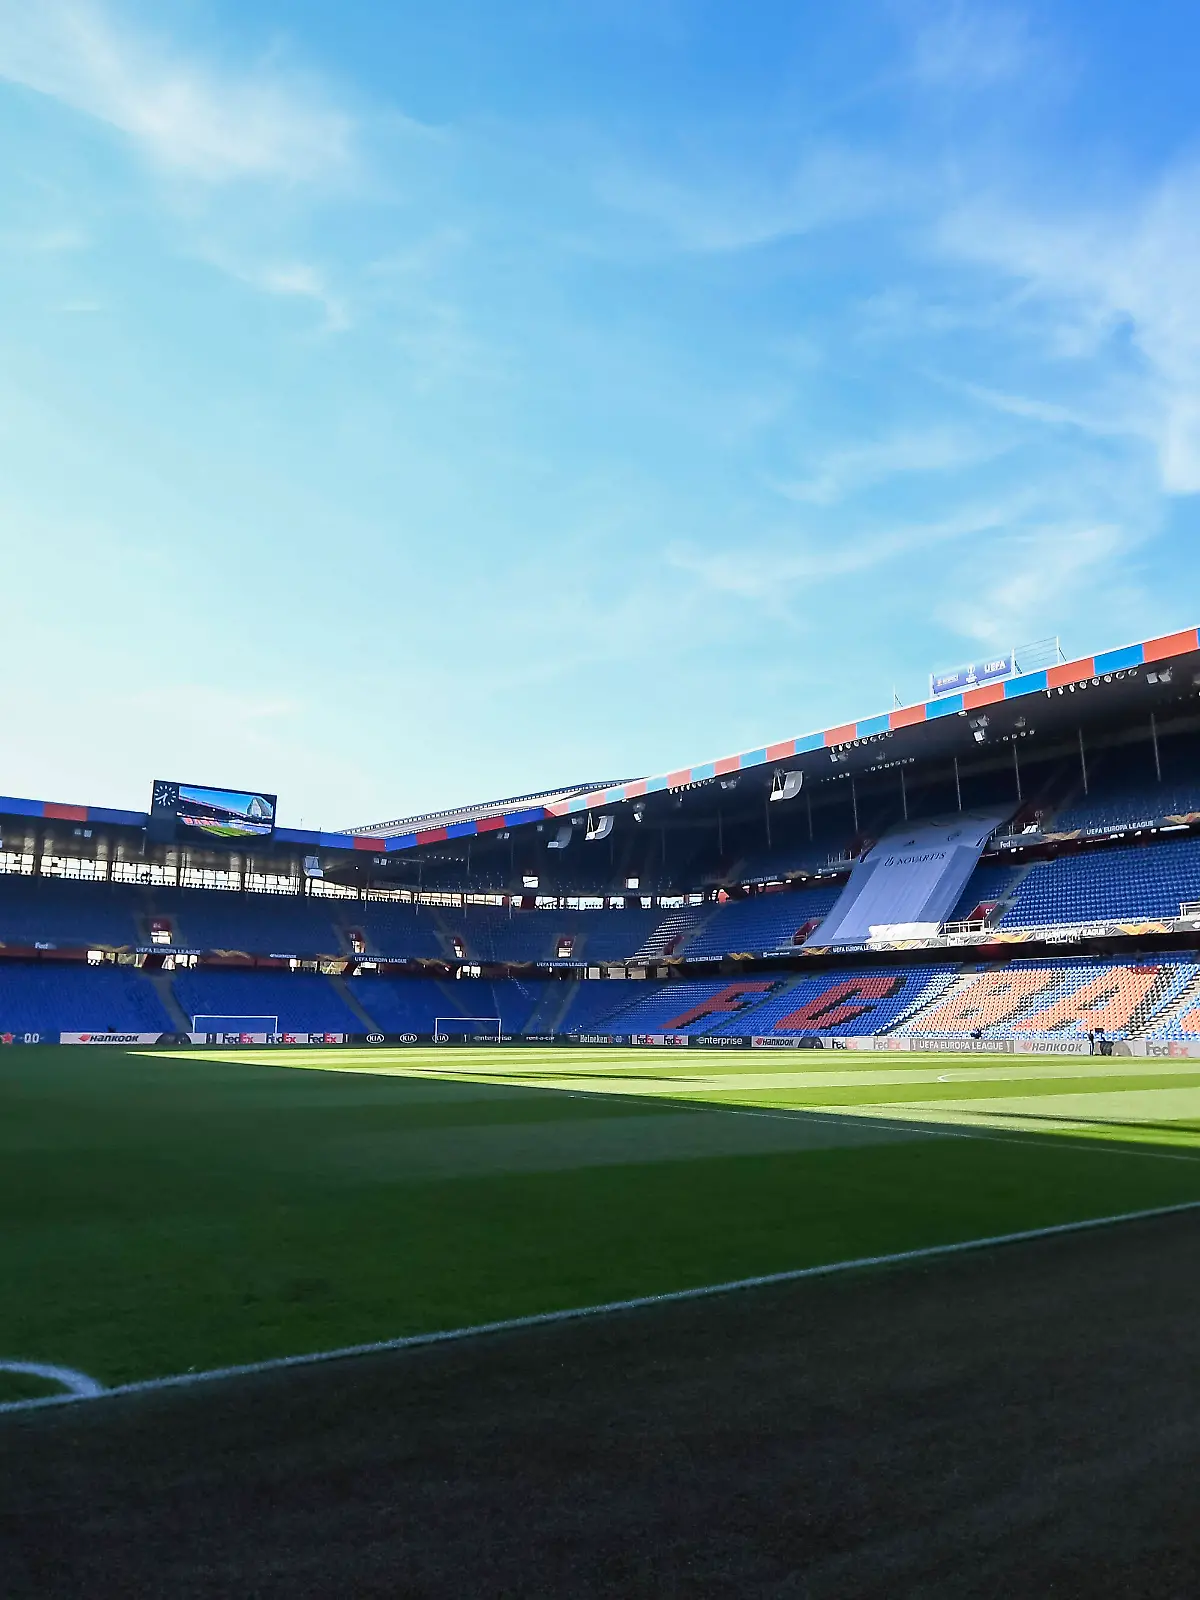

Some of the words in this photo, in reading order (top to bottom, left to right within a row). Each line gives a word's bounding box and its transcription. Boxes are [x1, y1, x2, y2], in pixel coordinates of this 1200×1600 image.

[984, 660, 1005, 674] UEFA
[1087, 827, 1103, 835] UEFA
[1103, 824, 1128, 833] EUROPA
[1128, 820, 1153, 829] LEAGUE
[897, 852, 946, 865] NOVARTIS
[223, 1034, 254, 1043] FedEx
[308, 1034, 337, 1043] FedEx
[368, 1034, 383, 1043] KIA
[401, 1034, 416, 1043] KIA
[580, 1034, 607, 1044] Heineken
[636, 1035, 654, 1044] FedEx
[664, 1035, 683, 1045] FedEx
[697, 1036, 743, 1045] enterprise
[832, 1039, 858, 1049] FedEx
[874, 1040, 901, 1049] FedEx
[919, 1040, 939, 1049] UEFA
[940, 1040, 970, 1050] EUROPA
[971, 1041, 1004, 1050] LEAGUE
[1146, 1041, 1189, 1057] FedEx
